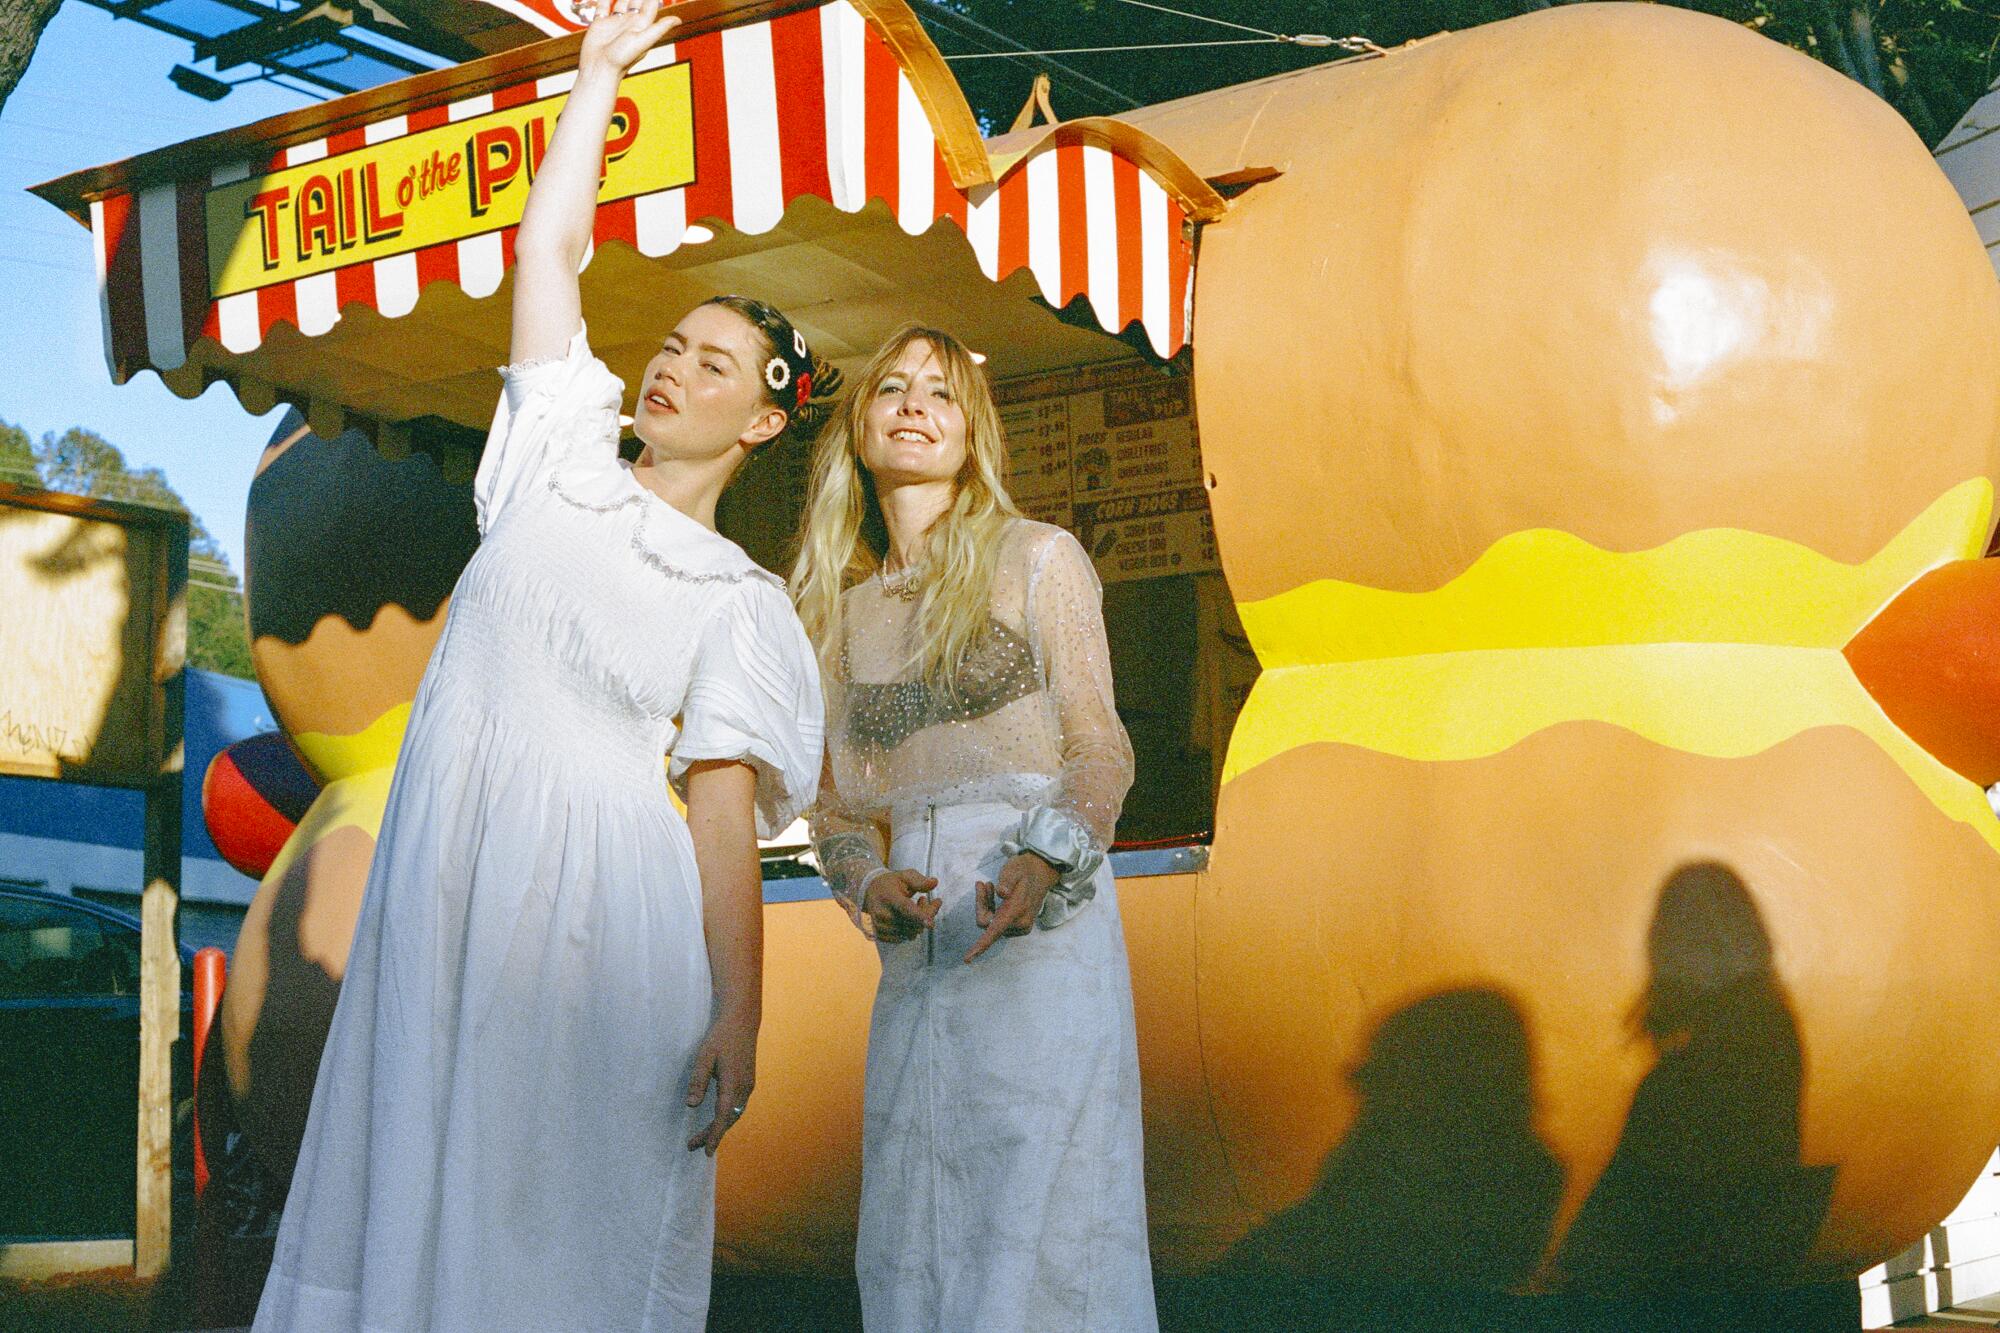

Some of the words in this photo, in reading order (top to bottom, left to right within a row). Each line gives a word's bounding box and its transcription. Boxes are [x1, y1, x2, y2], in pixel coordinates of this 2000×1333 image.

[245, 161, 404, 271] TAIL
[1096, 497, 1135, 519] CORN
[1138, 493, 1179, 514] DOGS
